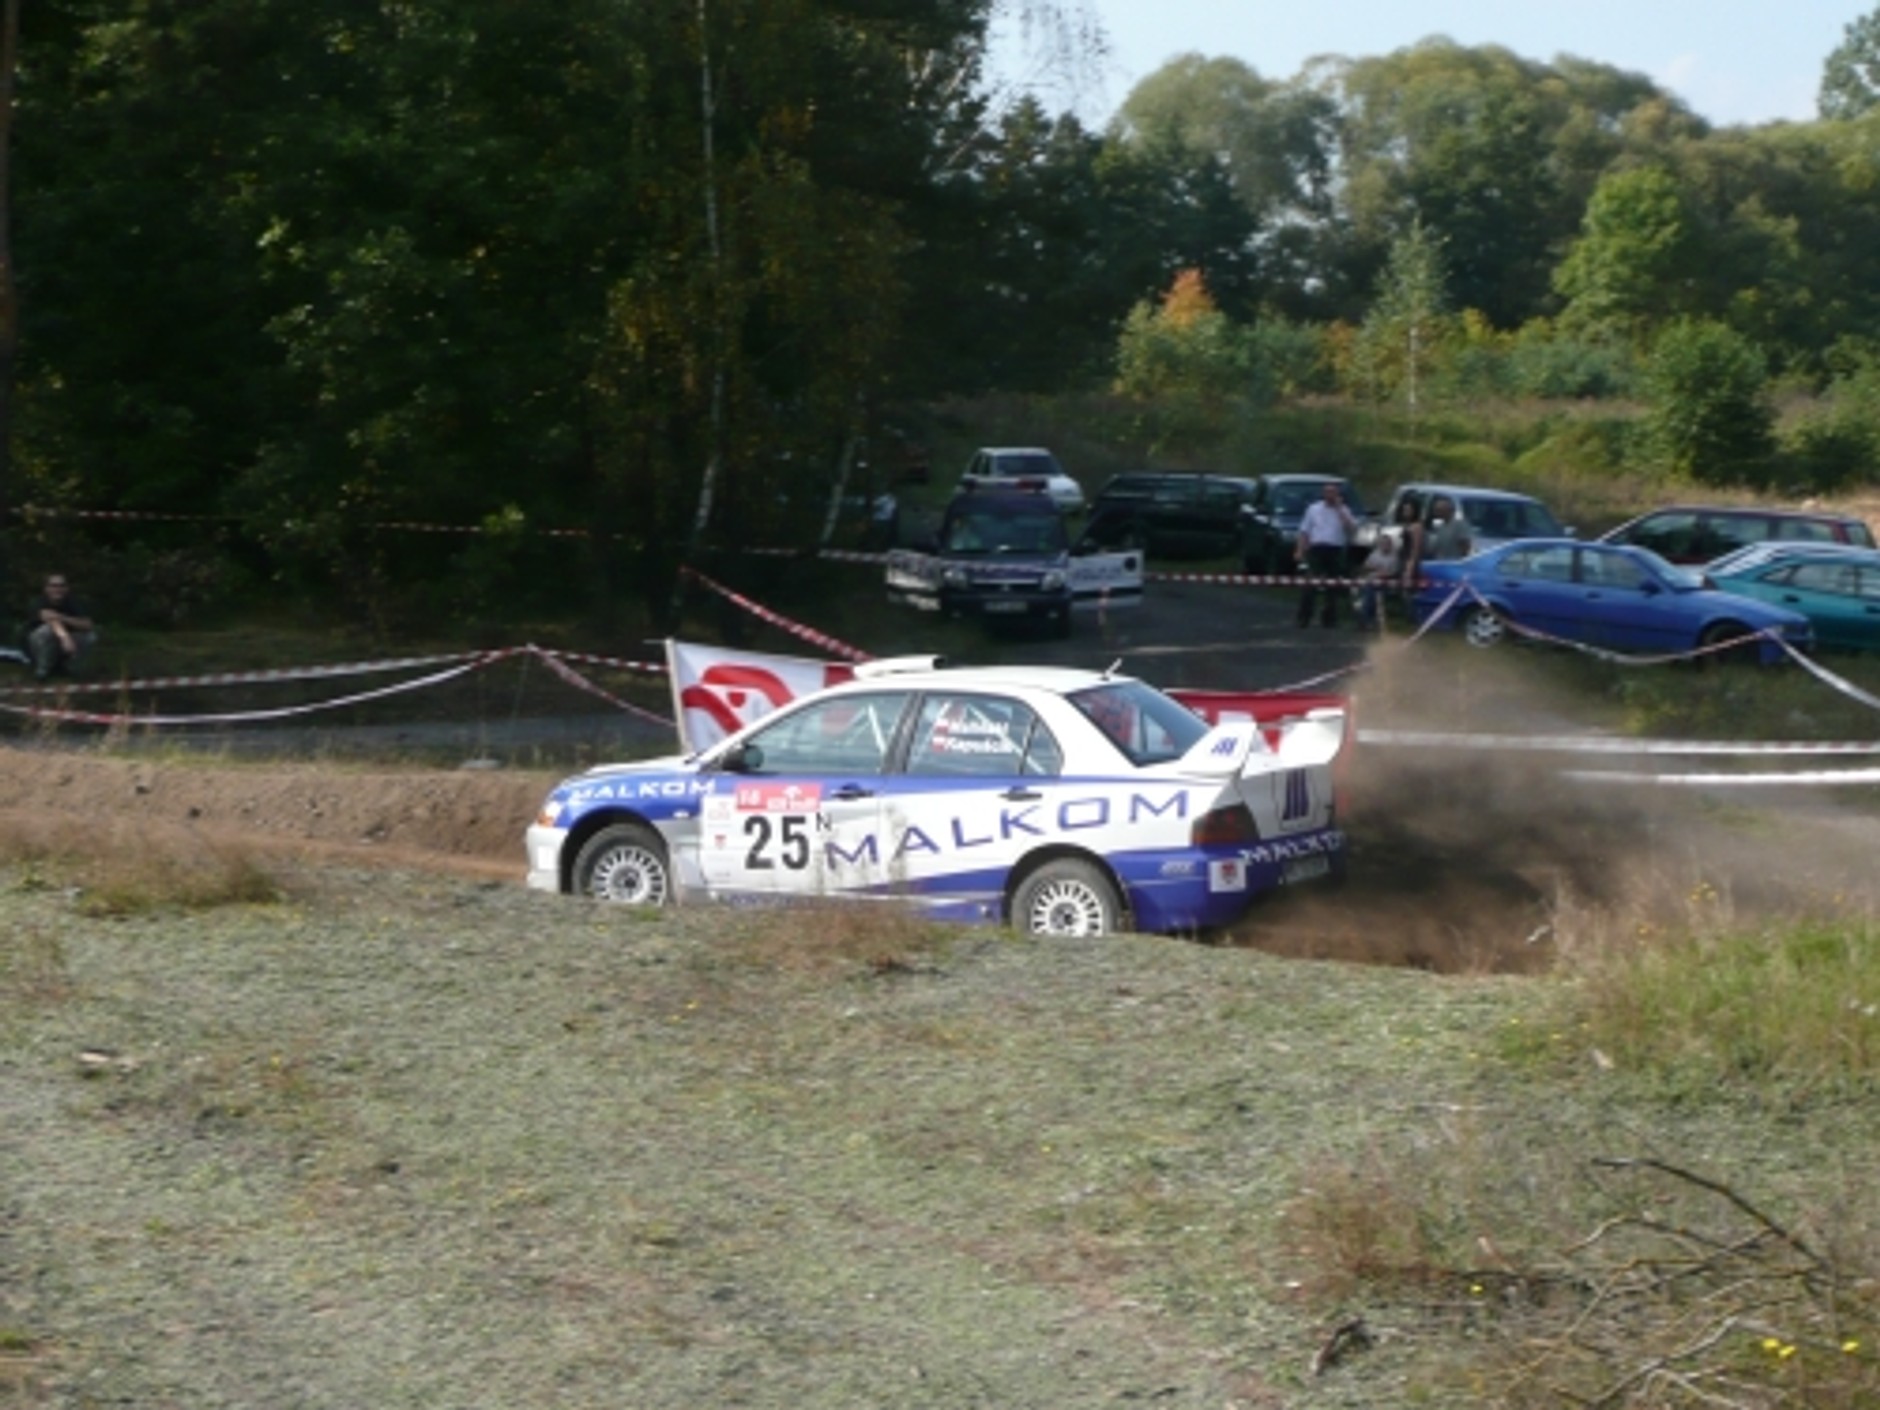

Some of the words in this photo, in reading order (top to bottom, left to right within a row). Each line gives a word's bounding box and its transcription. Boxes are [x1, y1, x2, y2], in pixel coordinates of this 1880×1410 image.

[569, 779, 716, 805] MALKOM
[743, 814, 810, 870] 25
[816, 812, 832, 832] N
[823, 789, 1189, 870] MALKOM
